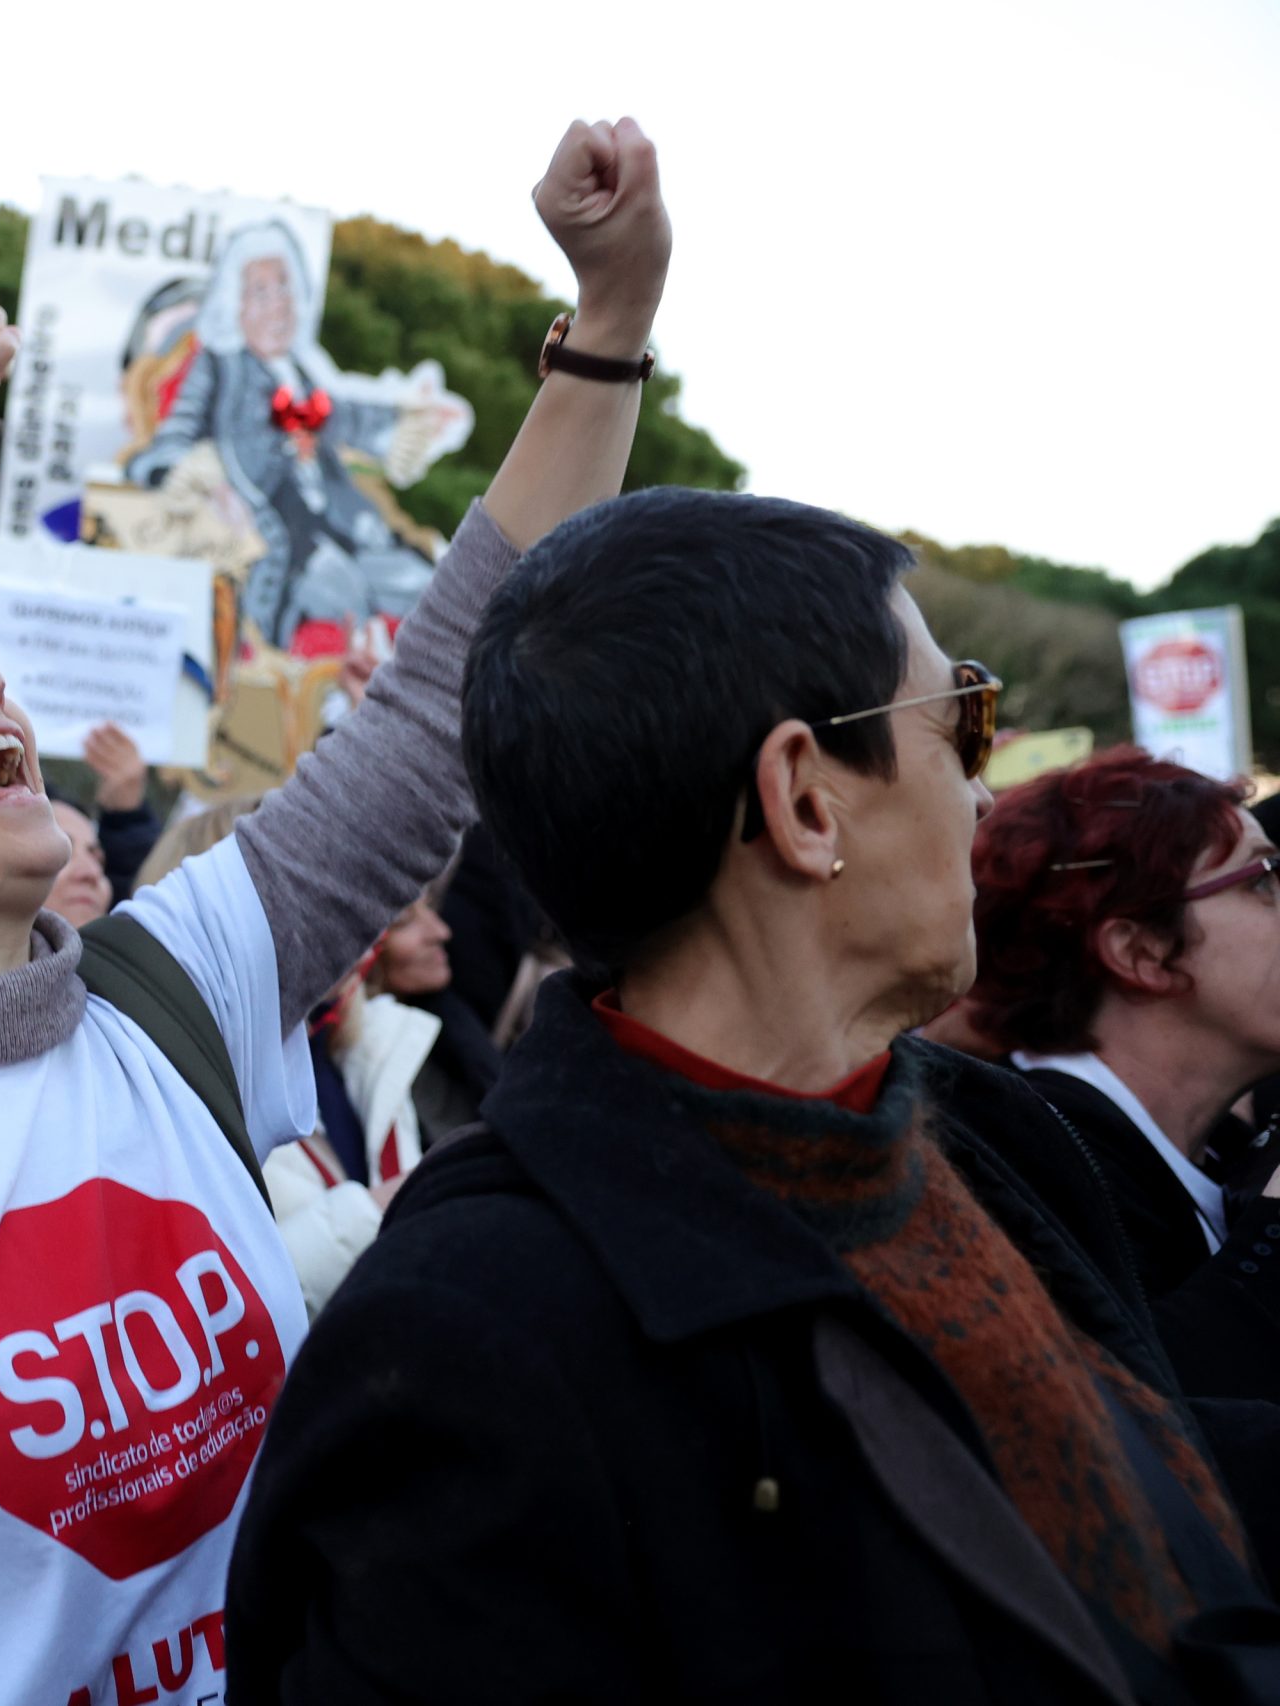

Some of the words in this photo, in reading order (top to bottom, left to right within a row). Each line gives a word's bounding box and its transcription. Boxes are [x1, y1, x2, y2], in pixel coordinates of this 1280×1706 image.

[50, 1464, 174, 1536] profissionais
[175, 1450, 198, 1479] de
[200, 1404, 266, 1464] educação
[65, 1444, 148, 1492] sindicato
[149, 1429, 172, 1457] de
